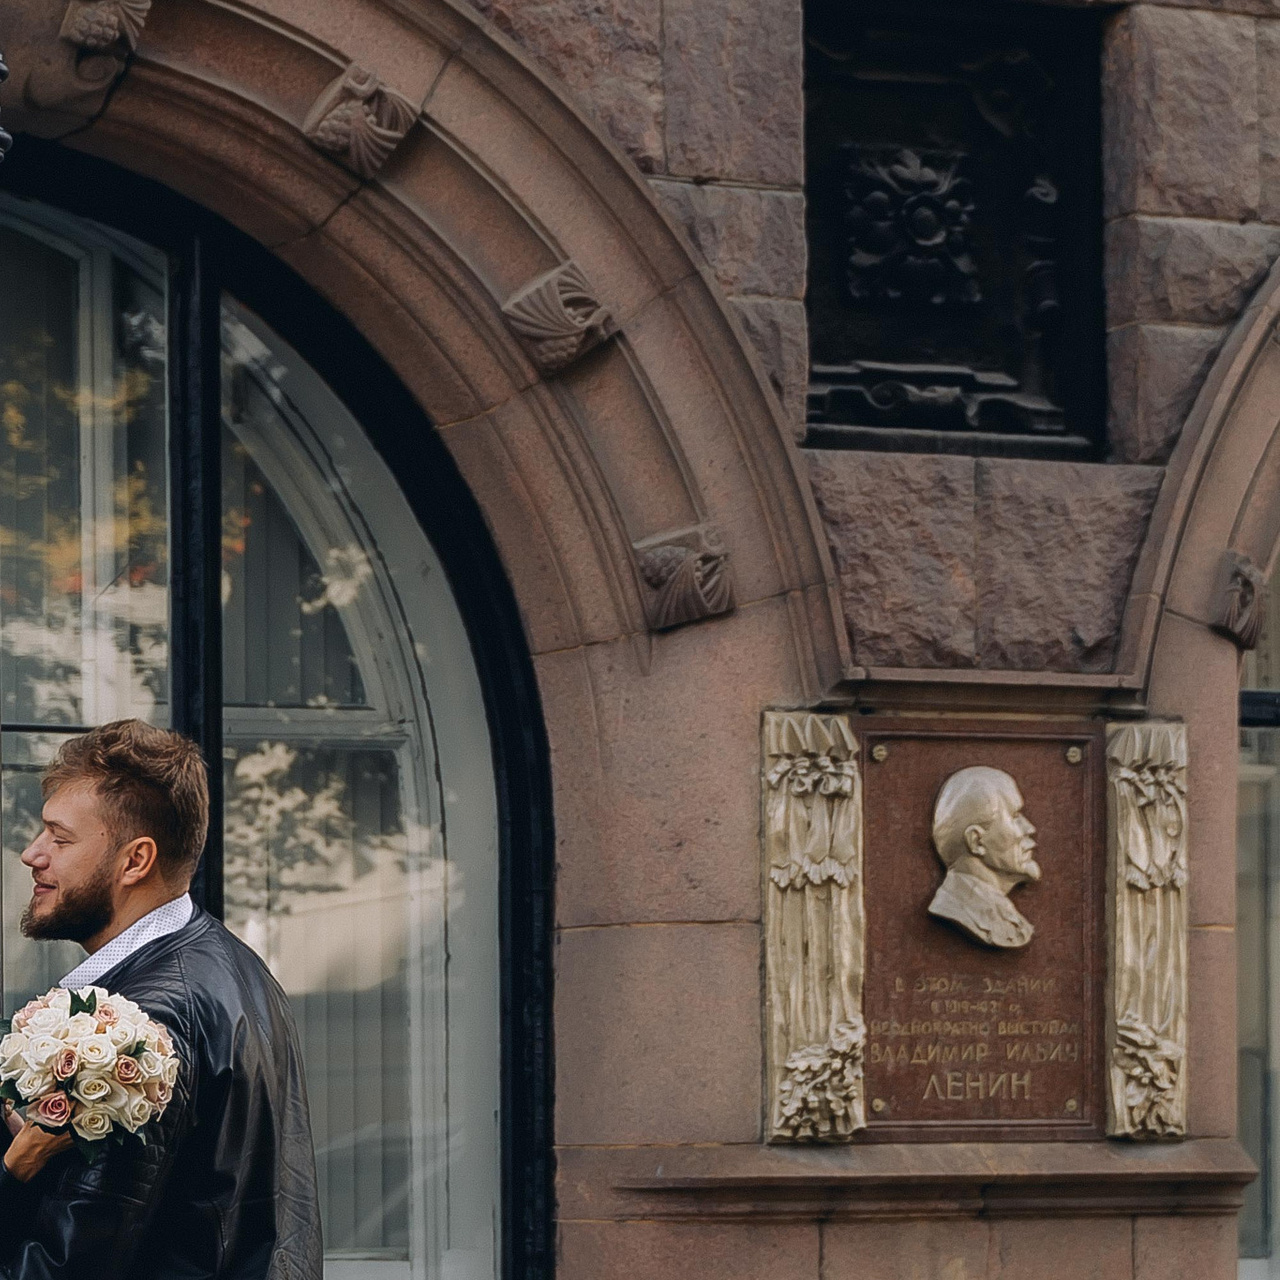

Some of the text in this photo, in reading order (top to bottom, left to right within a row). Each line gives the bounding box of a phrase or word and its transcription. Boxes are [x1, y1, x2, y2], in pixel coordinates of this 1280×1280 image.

[983, 977, 1056, 994] ЗДАНИИ
[997, 1019, 1080, 1036] ВЫСТУПАЛ
[870, 1041, 1079, 1065] ВЛАДИМИР ИЛЬИЧ
[923, 1070, 1032, 1100] ЛЕНИН
